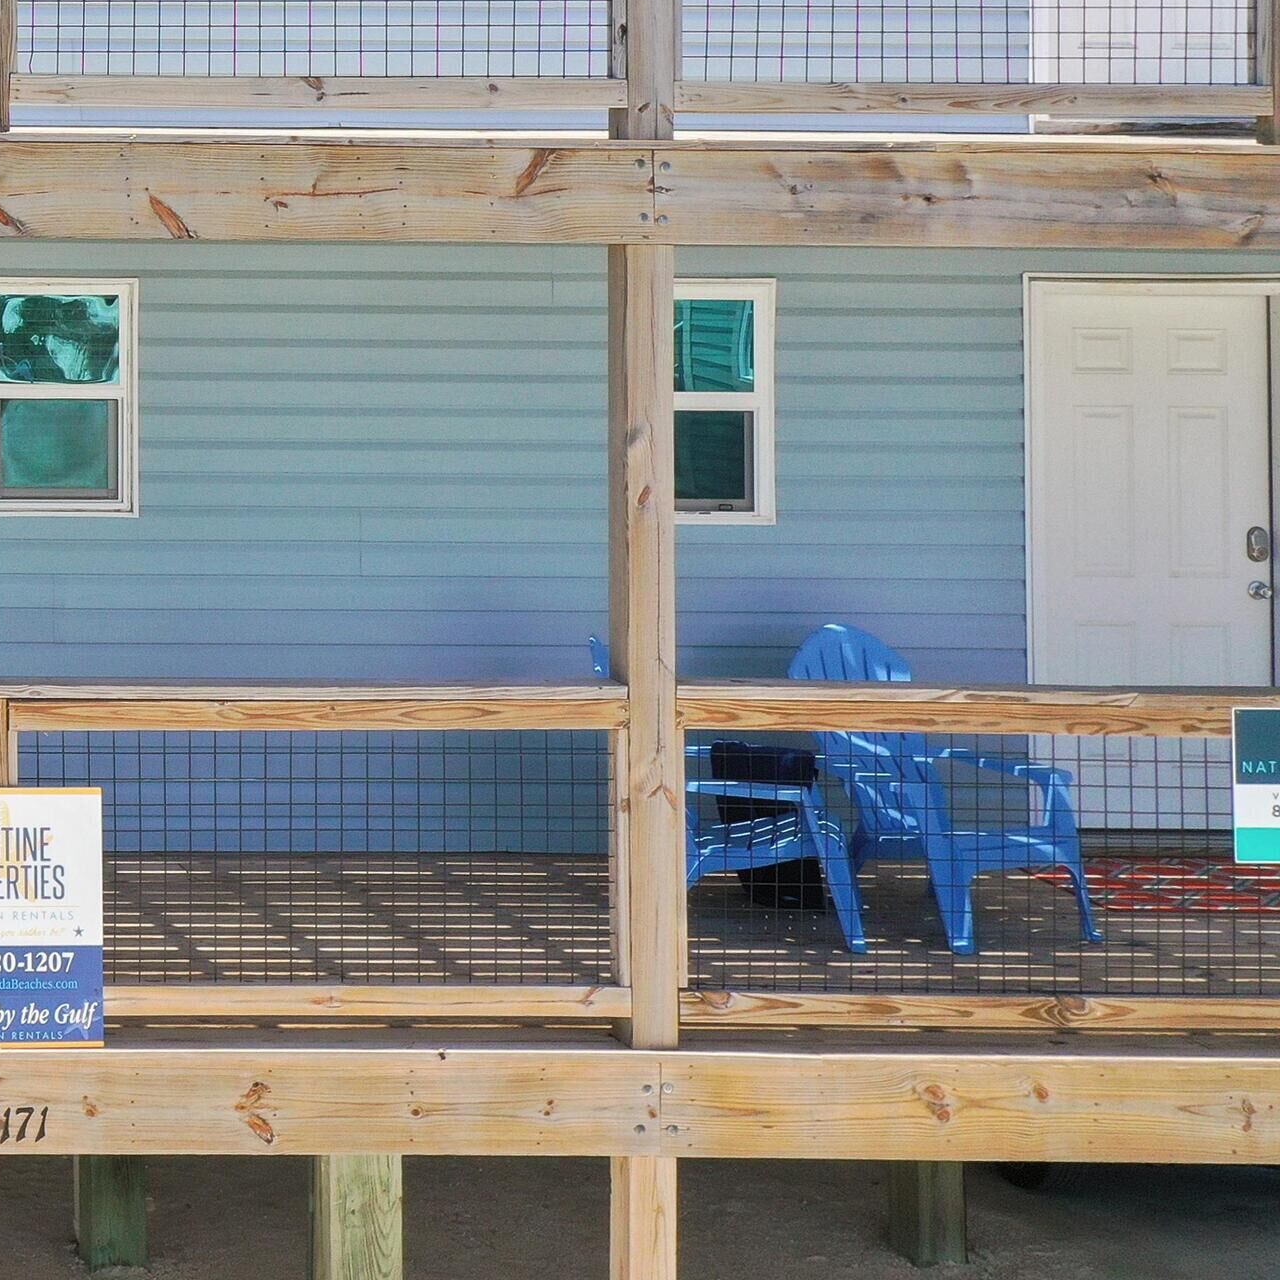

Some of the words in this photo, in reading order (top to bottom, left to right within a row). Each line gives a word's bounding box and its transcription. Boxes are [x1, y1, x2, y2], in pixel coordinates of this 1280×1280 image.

[12, 910, 75, 921] RENTALS
[21, 1003, 49, 1025] the
[54, 1002, 98, 1030] Gulf
[11, 1031, 64, 1040] RENTALS
[0, 1106, 49, 1144] 171
